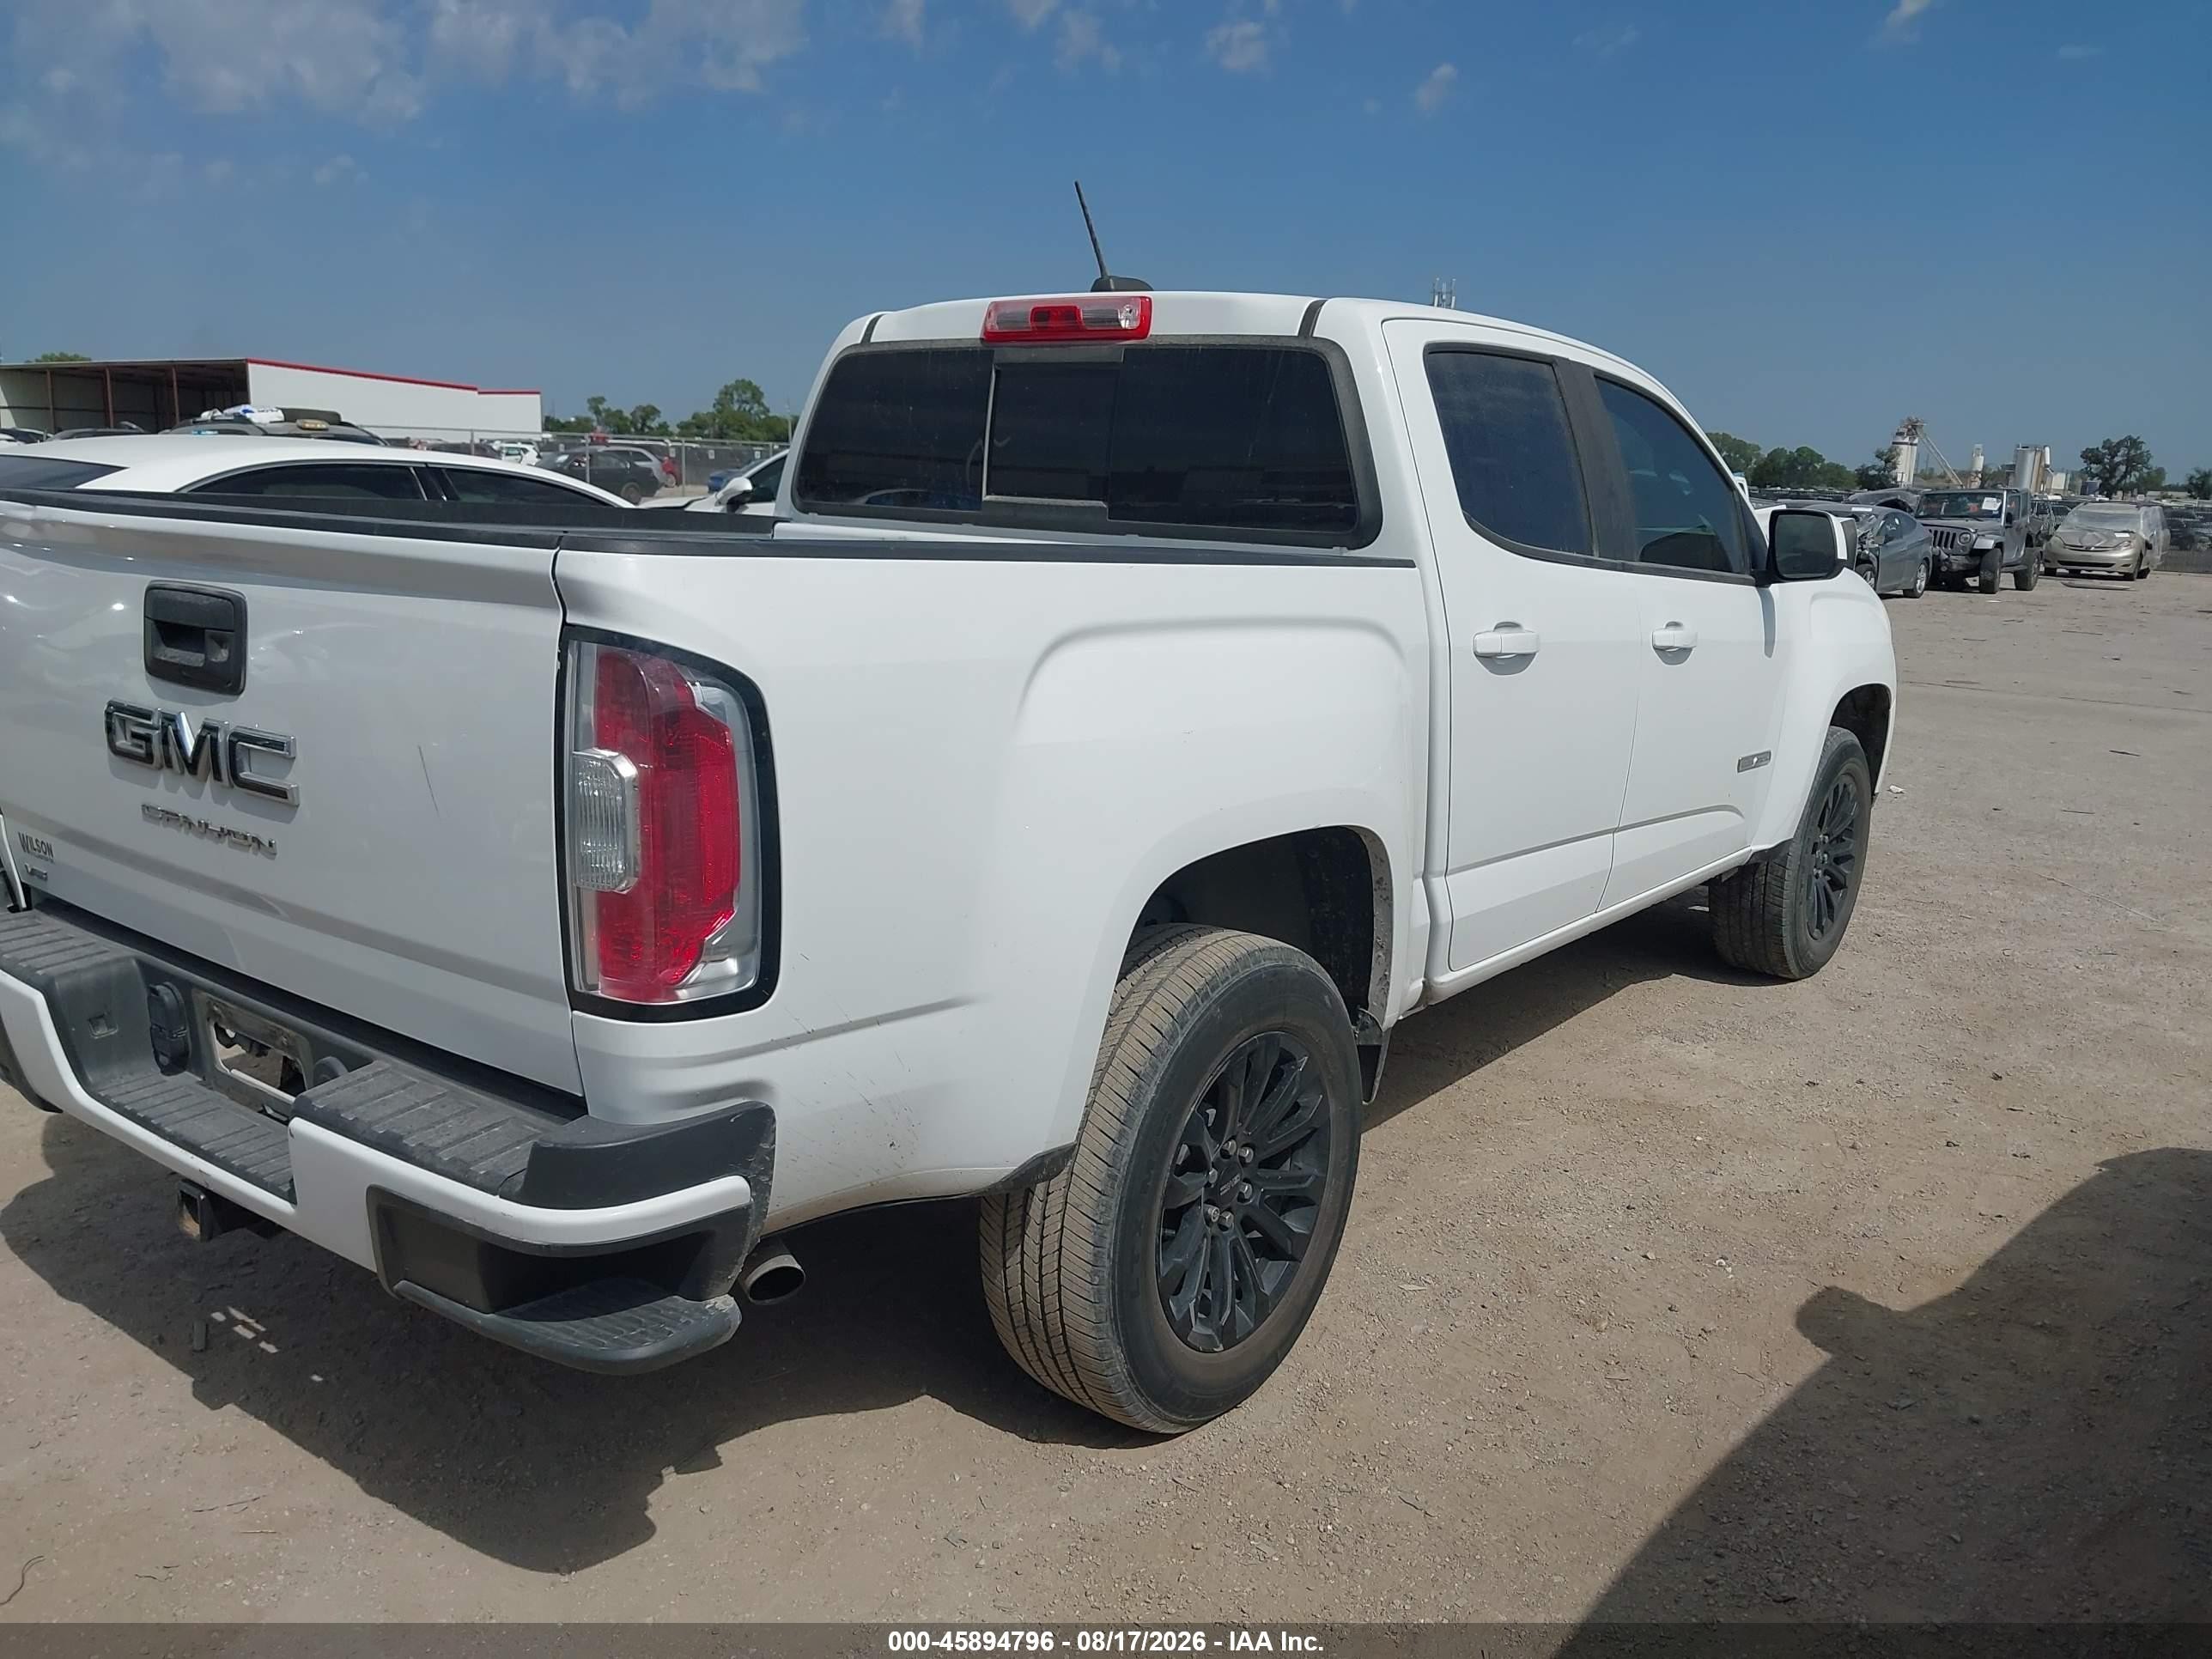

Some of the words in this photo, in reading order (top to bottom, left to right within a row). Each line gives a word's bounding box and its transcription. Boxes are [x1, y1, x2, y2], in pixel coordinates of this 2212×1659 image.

[104, 699, 301, 807] GMC
[17, 831, 54, 859] WILSON
[141, 803, 277, 859] CANYON
